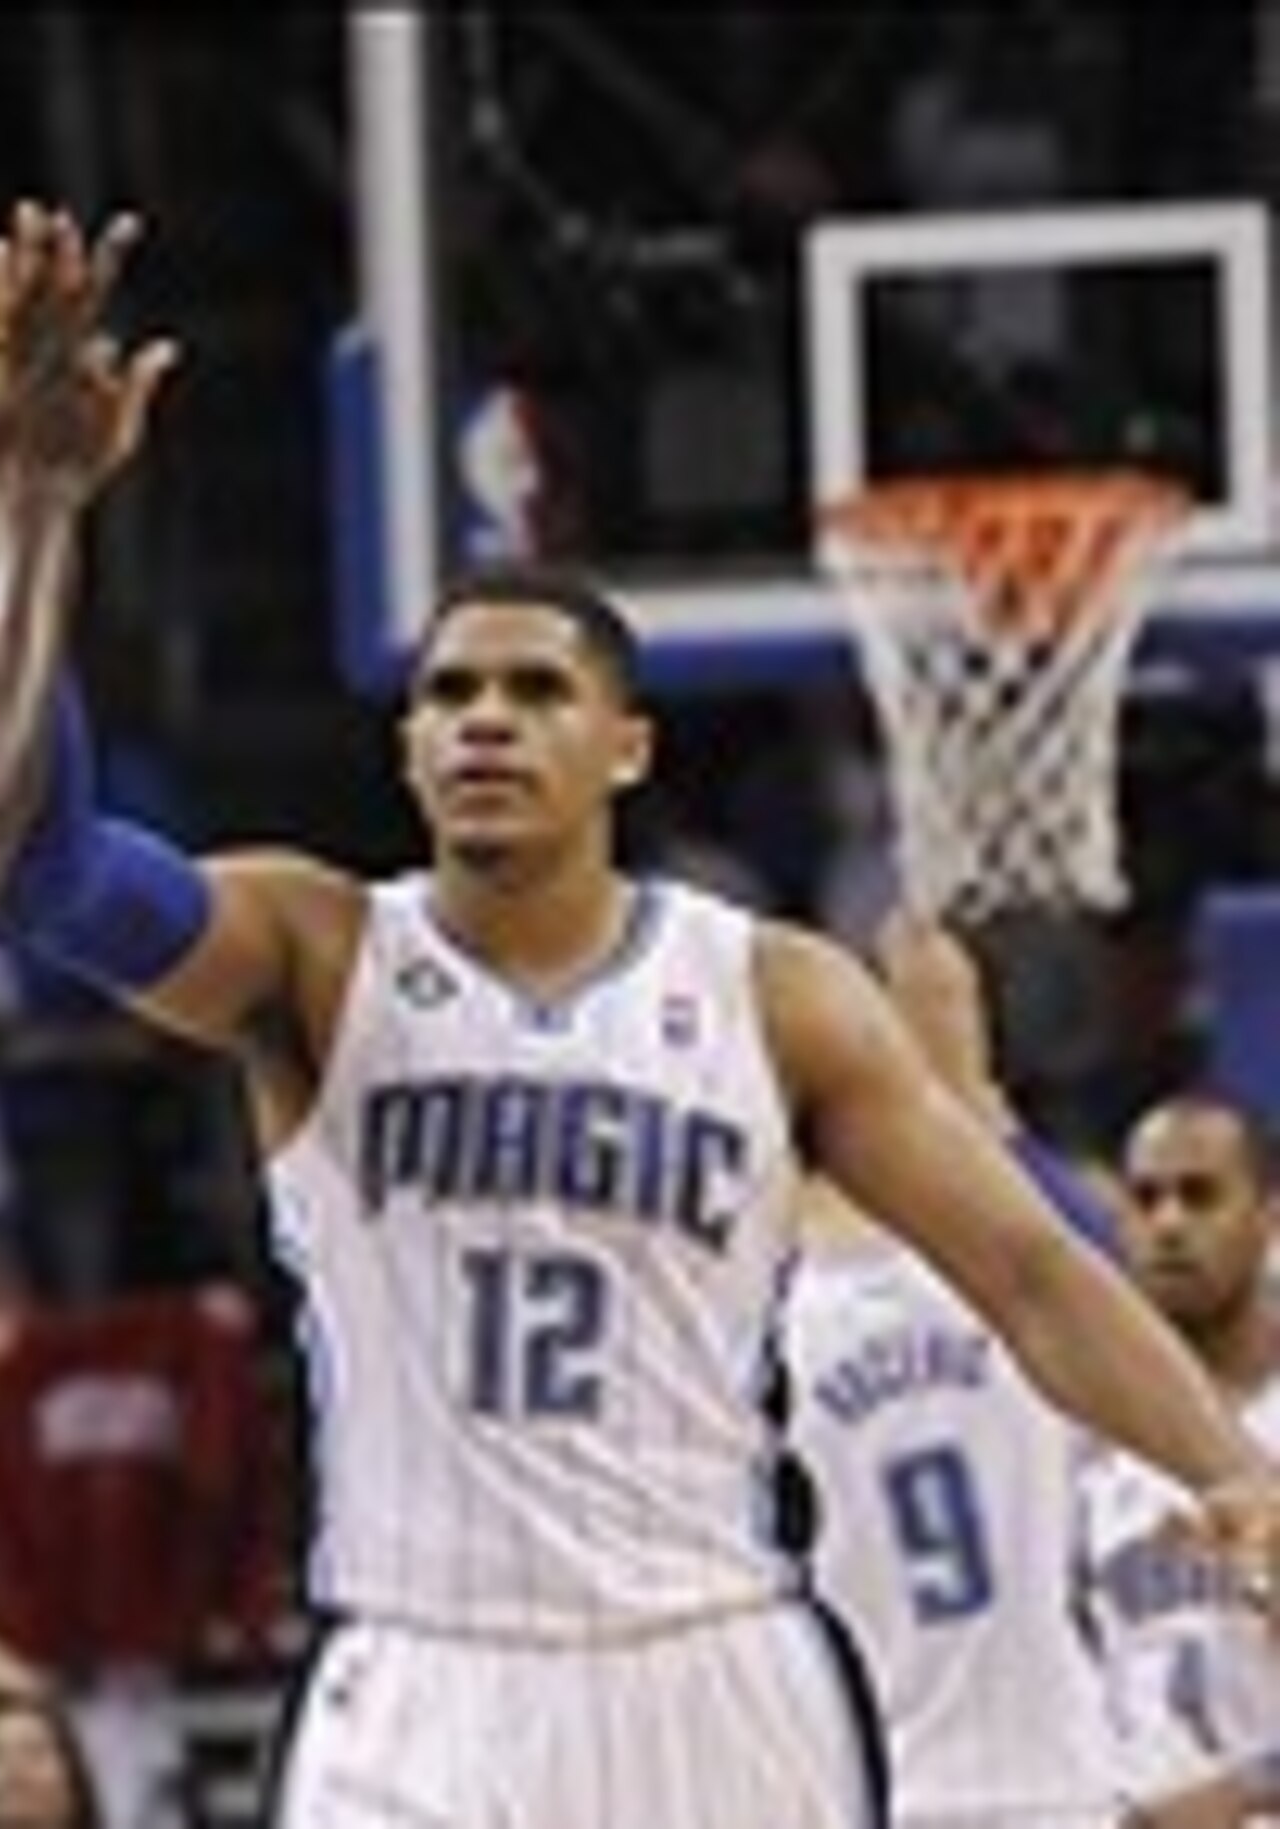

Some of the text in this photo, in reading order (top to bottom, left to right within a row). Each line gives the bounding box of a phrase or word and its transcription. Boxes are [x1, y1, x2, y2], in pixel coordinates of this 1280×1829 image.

[359, 1073, 747, 1260] MAGIC
[458, 1246, 608, 1421] 12
[883, 1442, 994, 1627] 9
